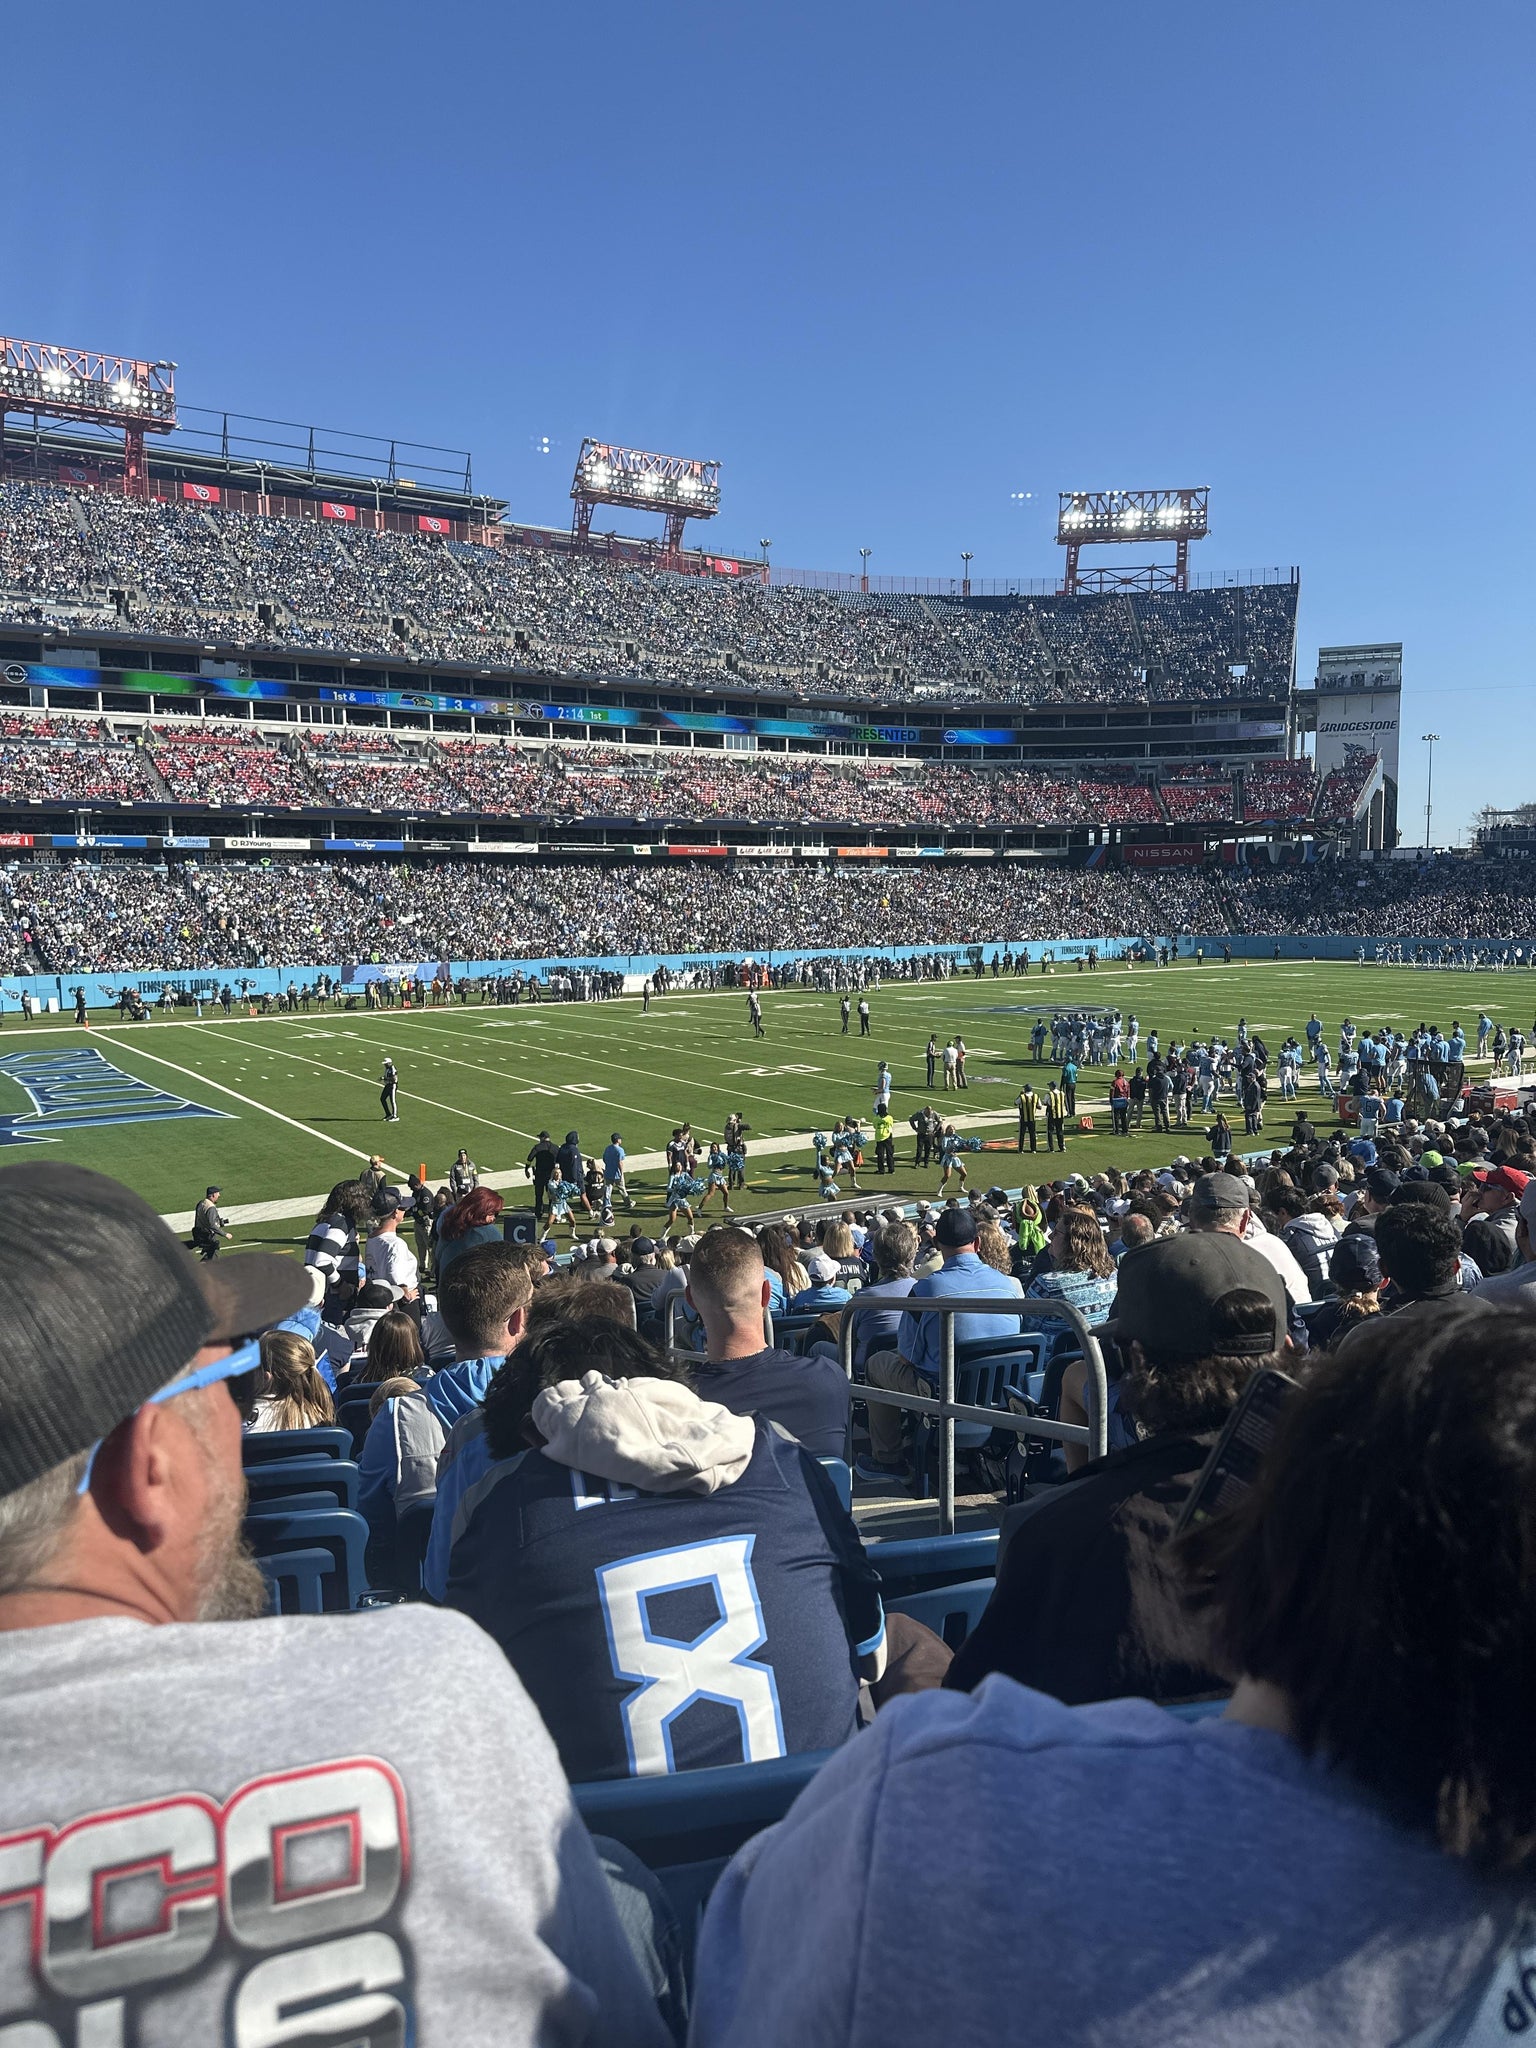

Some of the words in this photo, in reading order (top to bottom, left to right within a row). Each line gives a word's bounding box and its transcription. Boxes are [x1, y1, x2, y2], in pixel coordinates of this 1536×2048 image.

[333, 691, 347, 701] 1st
[348, 692, 357, 702] &
[454, 699, 463, 711] 3
[490, 702, 499, 714] 3
[557, 706, 585, 720] 2:14
[590, 711, 602, 720] 1st
[1319, 720, 1397, 732] BRIDGESTONE
[850, 728, 916, 741] PRESENTED
[33, 850, 58, 858] MIKE
[1134, 848, 1193, 857] NISSAN
[33, 857, 61, 865] KEITH
[1081, 1116, 1093, 1129] 20
[513, 1225, 527, 1244] C
[594, 1533, 788, 1777] 8
